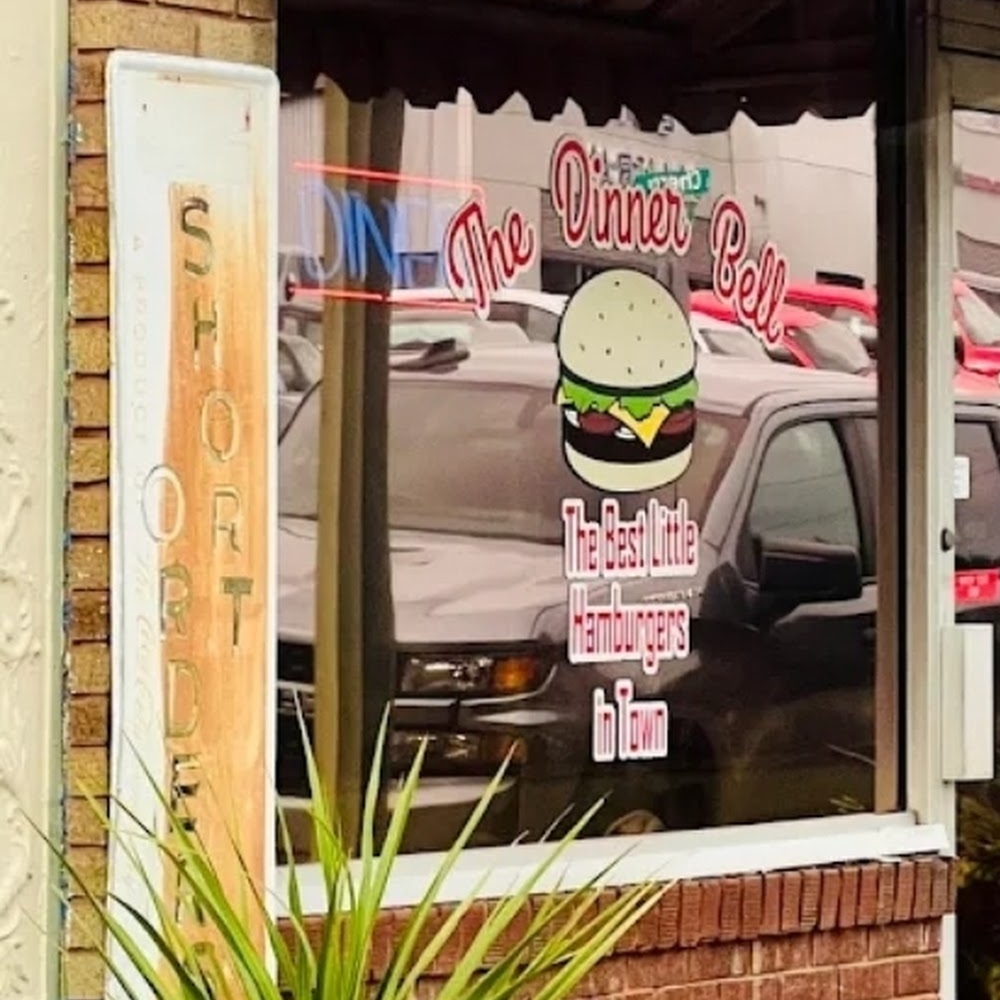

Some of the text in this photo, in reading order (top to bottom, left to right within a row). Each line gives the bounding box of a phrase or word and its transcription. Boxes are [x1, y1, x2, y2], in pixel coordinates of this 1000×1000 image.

[444, 134, 787, 347] The Dinner Bell
[179, 196, 254, 648] SHORT
[562, 498, 699, 578] The Best Little
[568, 582, 690, 674] Hamburgers
[593, 679, 668, 762] In Town
